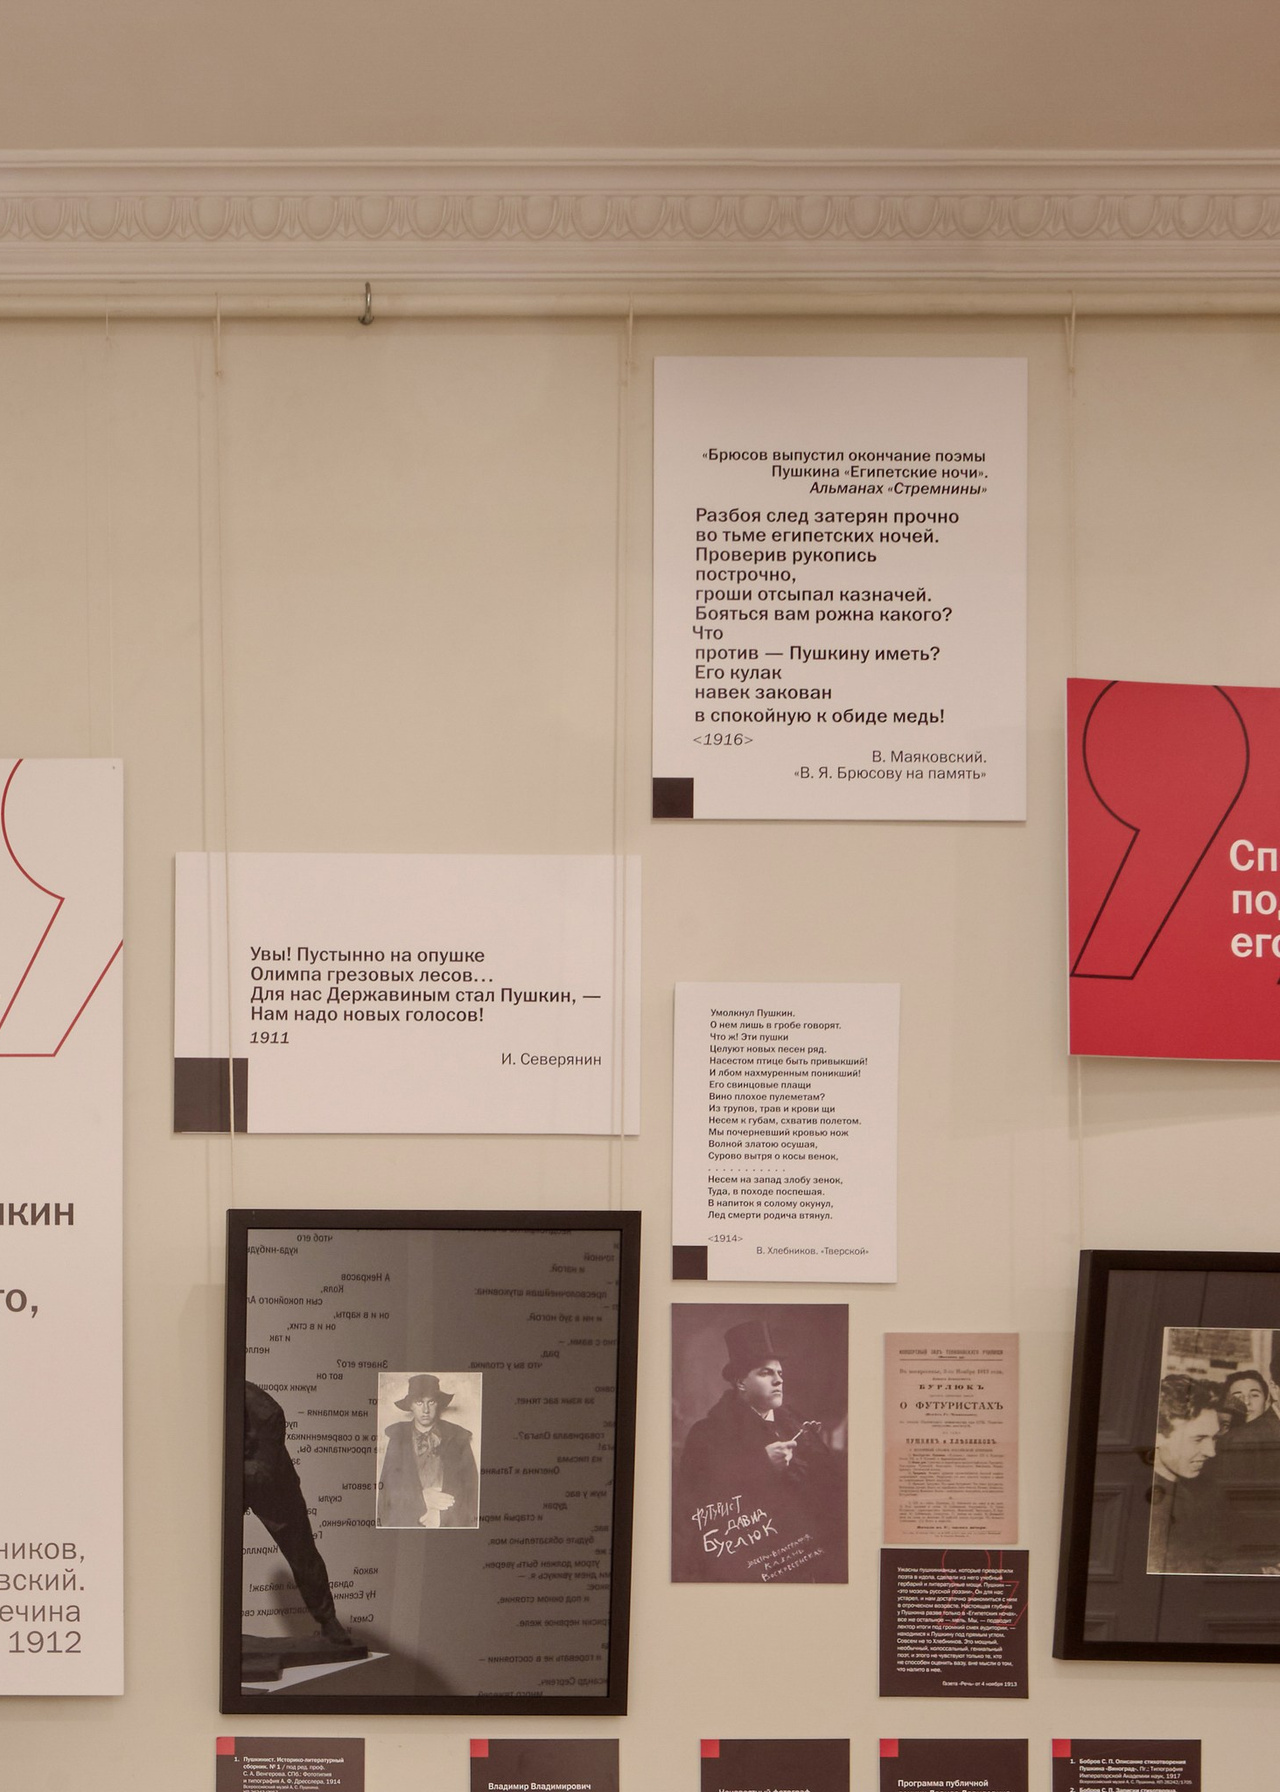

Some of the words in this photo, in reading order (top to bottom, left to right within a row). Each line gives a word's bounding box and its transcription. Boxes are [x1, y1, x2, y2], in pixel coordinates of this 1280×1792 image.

[702, 448, 768, 463] «Брюсов
[772, 451, 844, 464] выпустил
[848, 451, 931, 462] окончание
[935, 452, 986, 463] поэмы
[771, 464, 840, 481] Пушкина
[844, 465, 937, 479] «Египетские
[941, 468, 988, 479] ночи».
[809, 481, 884, 495] Альманах
[887, 481, 987, 497] «Стремнины»
[696, 507, 761, 523] Разбоя
[766, 511, 809, 525] след
[814, 511, 888, 527] затерян
[893, 511, 959, 527] прочно
[696, 530, 718, 542] во
[722, 530, 767, 543] тьме
[771, 530, 874, 543] египетских
[879, 528, 939, 543] ночей.
[695, 605, 769, 621] Бояться
[774, 609, 810, 621] вам
[815, 609, 874, 624] рожна
[879, 606, 953, 622] какого?
[692, 625, 724, 641] Что
[695, 711, 705, 722] в
[710, 707, 812, 726] спокойную
[817, 711, 827, 723] к
[831, 708, 888, 726] обиде
[893, 708, 945, 726] медь!
[693, 732, 754, 747] <1916>
[872, 749, 886, 763] В.
[890, 750, 987, 764] Маяковский.
[1233, 890, 1280, 920] по
[250, 946, 291, 961] Увы!
[297, 946, 385, 965] Пустынно
[390, 950, 412, 963] на
[417, 950, 485, 966] опушке
[250, 965, 322, 982] Олимпа
[327, 970, 415, 985] грезовых
[418, 970, 493, 983] лесов…
[250, 985, 285, 1004] Для
[290, 989, 322, 1002] нас
[326, 986, 450, 1005] Державиным
[455, 990, 495, 1003] стал
[501, 987, 576, 1006] Пушкин,
[251, 1005, 288, 1021] Нам
[294, 1009, 338, 1024] надо
[343, 1009, 401, 1022] новых
[405, 1007, 484, 1022] голосов!
[710, 1008, 755, 1019] Умолкнул
[756, 1008, 796, 1019] Пушкин.
[249, 1030, 290, 1045] 1911
[709, 1044, 745, 1055] Целуют
[777, 1046, 806, 1054] песен
[807, 1046, 827, 1055] ряд.
[501, 1052, 516, 1065] И.
[520, 1052, 602, 1068] Северянин
[709, 1056, 755, 1065] Насестом
[756, 1058, 784, 1066] птице
[785, 1057, 809, 1065] быть
[810, 1057, 868, 1067] привыкший!
[707, 1233, 743, 1243] <1914>
[756, 1246, 765, 1255] В.
[767, 1246, 819, 1255] Хлебников.
[820, 1246, 869, 1257] «Тверской»
[8, 1630, 82, 1654] 1912
[488, 1782, 530, 1792] Владимир
[530, 1782, 592, 1792] Владимирович
